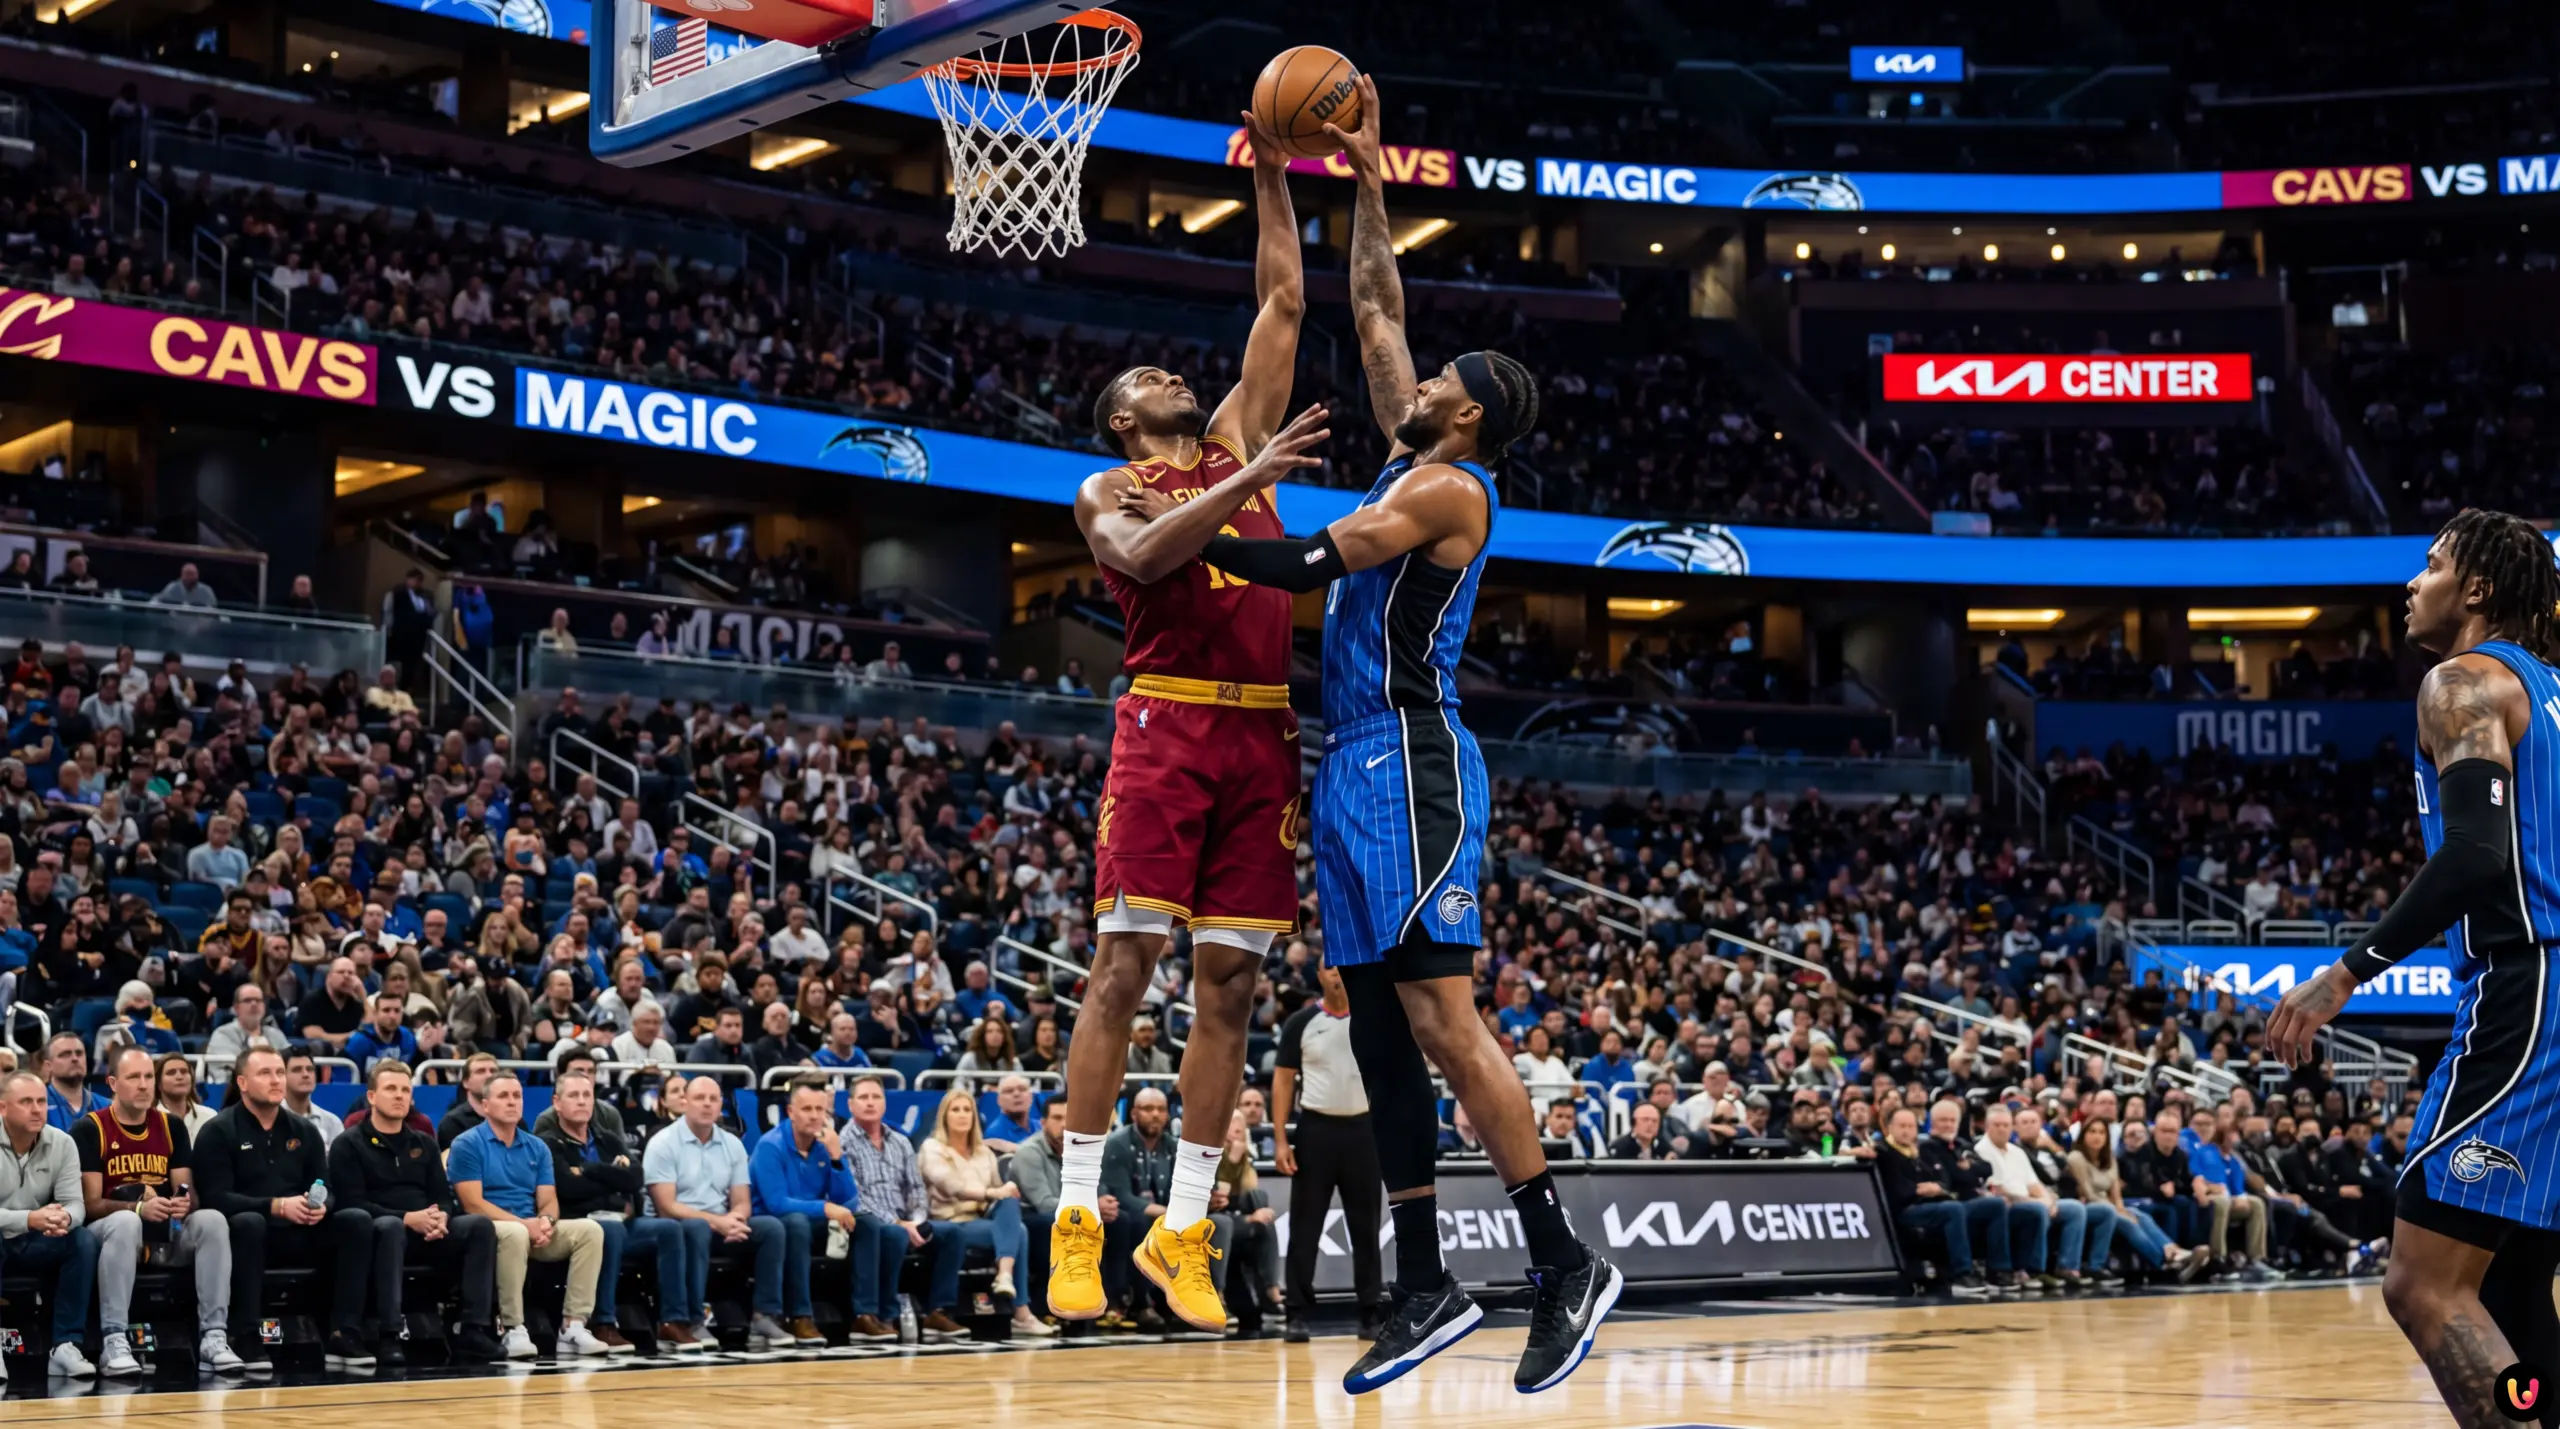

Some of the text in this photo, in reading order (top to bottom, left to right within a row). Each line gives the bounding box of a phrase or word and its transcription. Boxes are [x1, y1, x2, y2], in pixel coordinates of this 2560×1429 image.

[1464, 156, 1527, 191] VS
[1542, 160, 1697, 204] MAGIC
[2272, 166, 2405, 205] CAVS
[2421, 164, 2488, 196] VS
[150, 317, 758, 456] CAVS VS MAGIC
[2061, 361, 2219, 396] CENTER
[2177, 710, 2322, 757] MAGIC
[1741, 1203, 1870, 1242] CENTER
